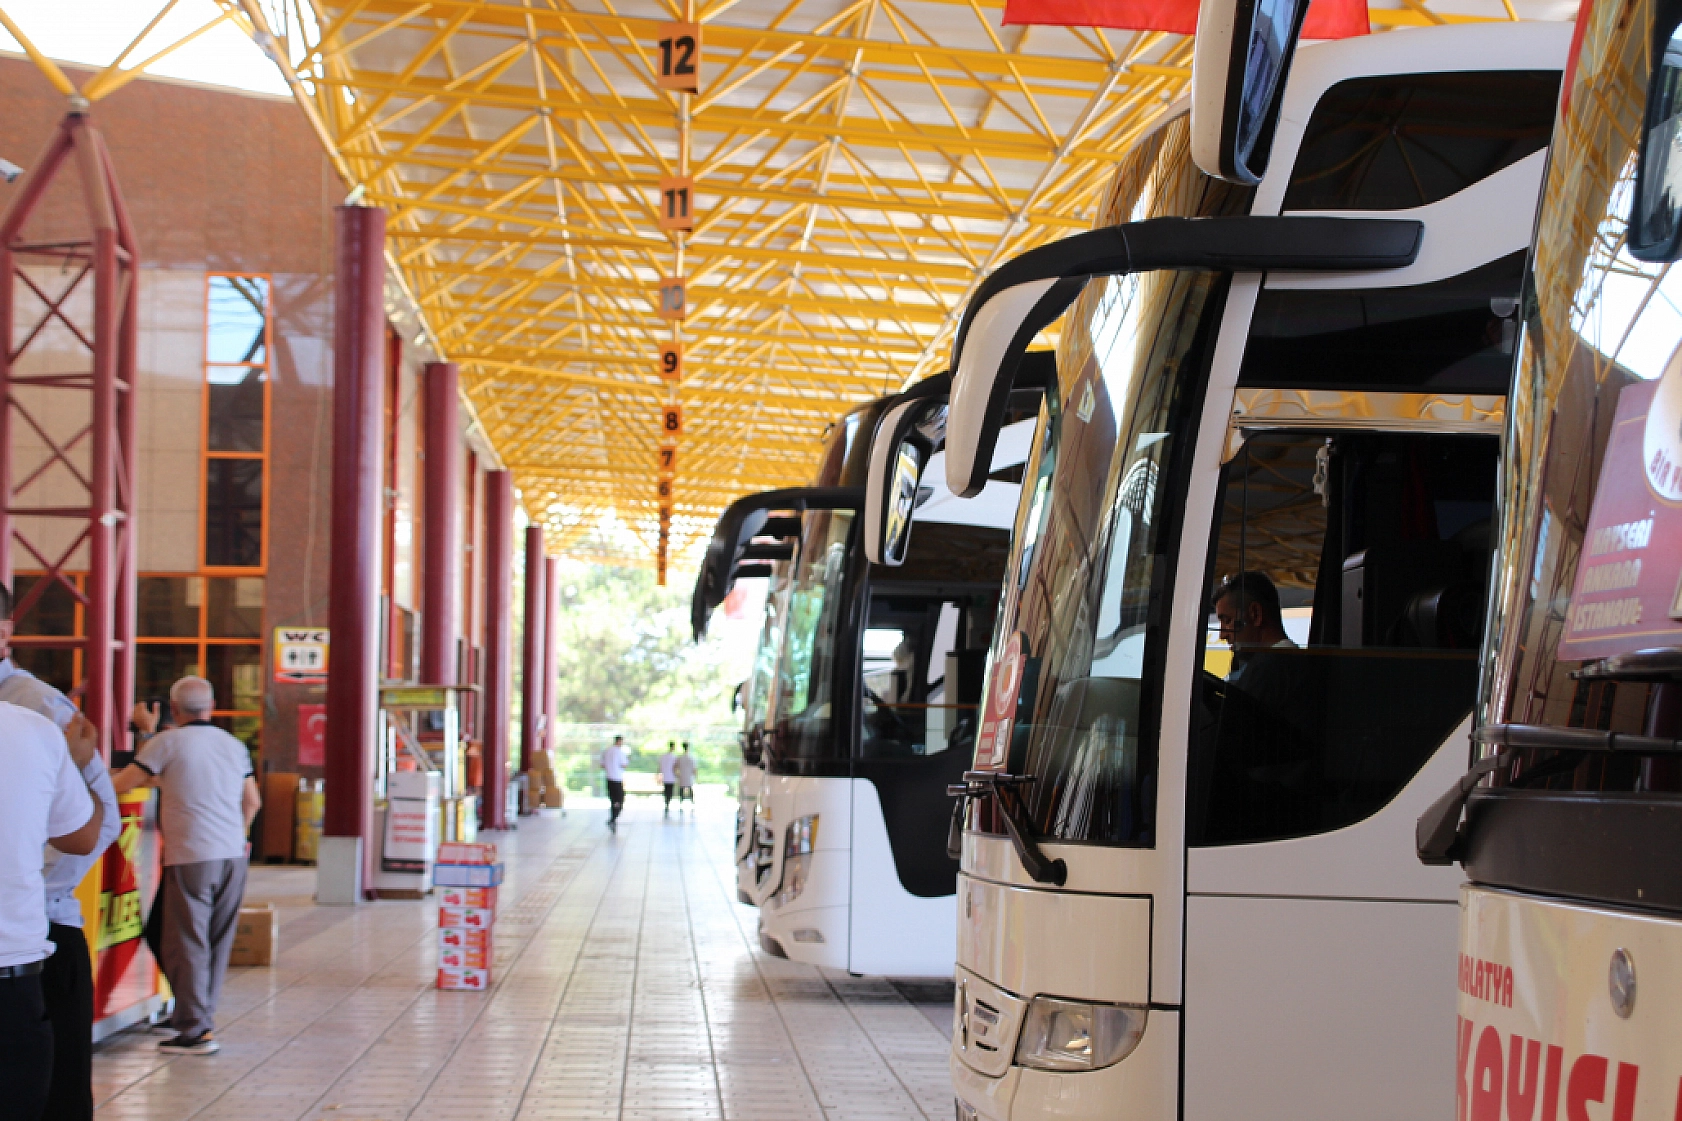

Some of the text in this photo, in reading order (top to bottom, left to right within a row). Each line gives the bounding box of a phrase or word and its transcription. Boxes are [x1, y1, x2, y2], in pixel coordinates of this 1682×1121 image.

[659, 36, 695, 76] 12
[664, 188, 688, 219] 11
[661, 285, 683, 311] 10
[664, 351, 678, 374] 9
[665, 411, 678, 431] 8
[661, 450, 673, 467] 7
[1581, 558, 1642, 594] ANKARA
